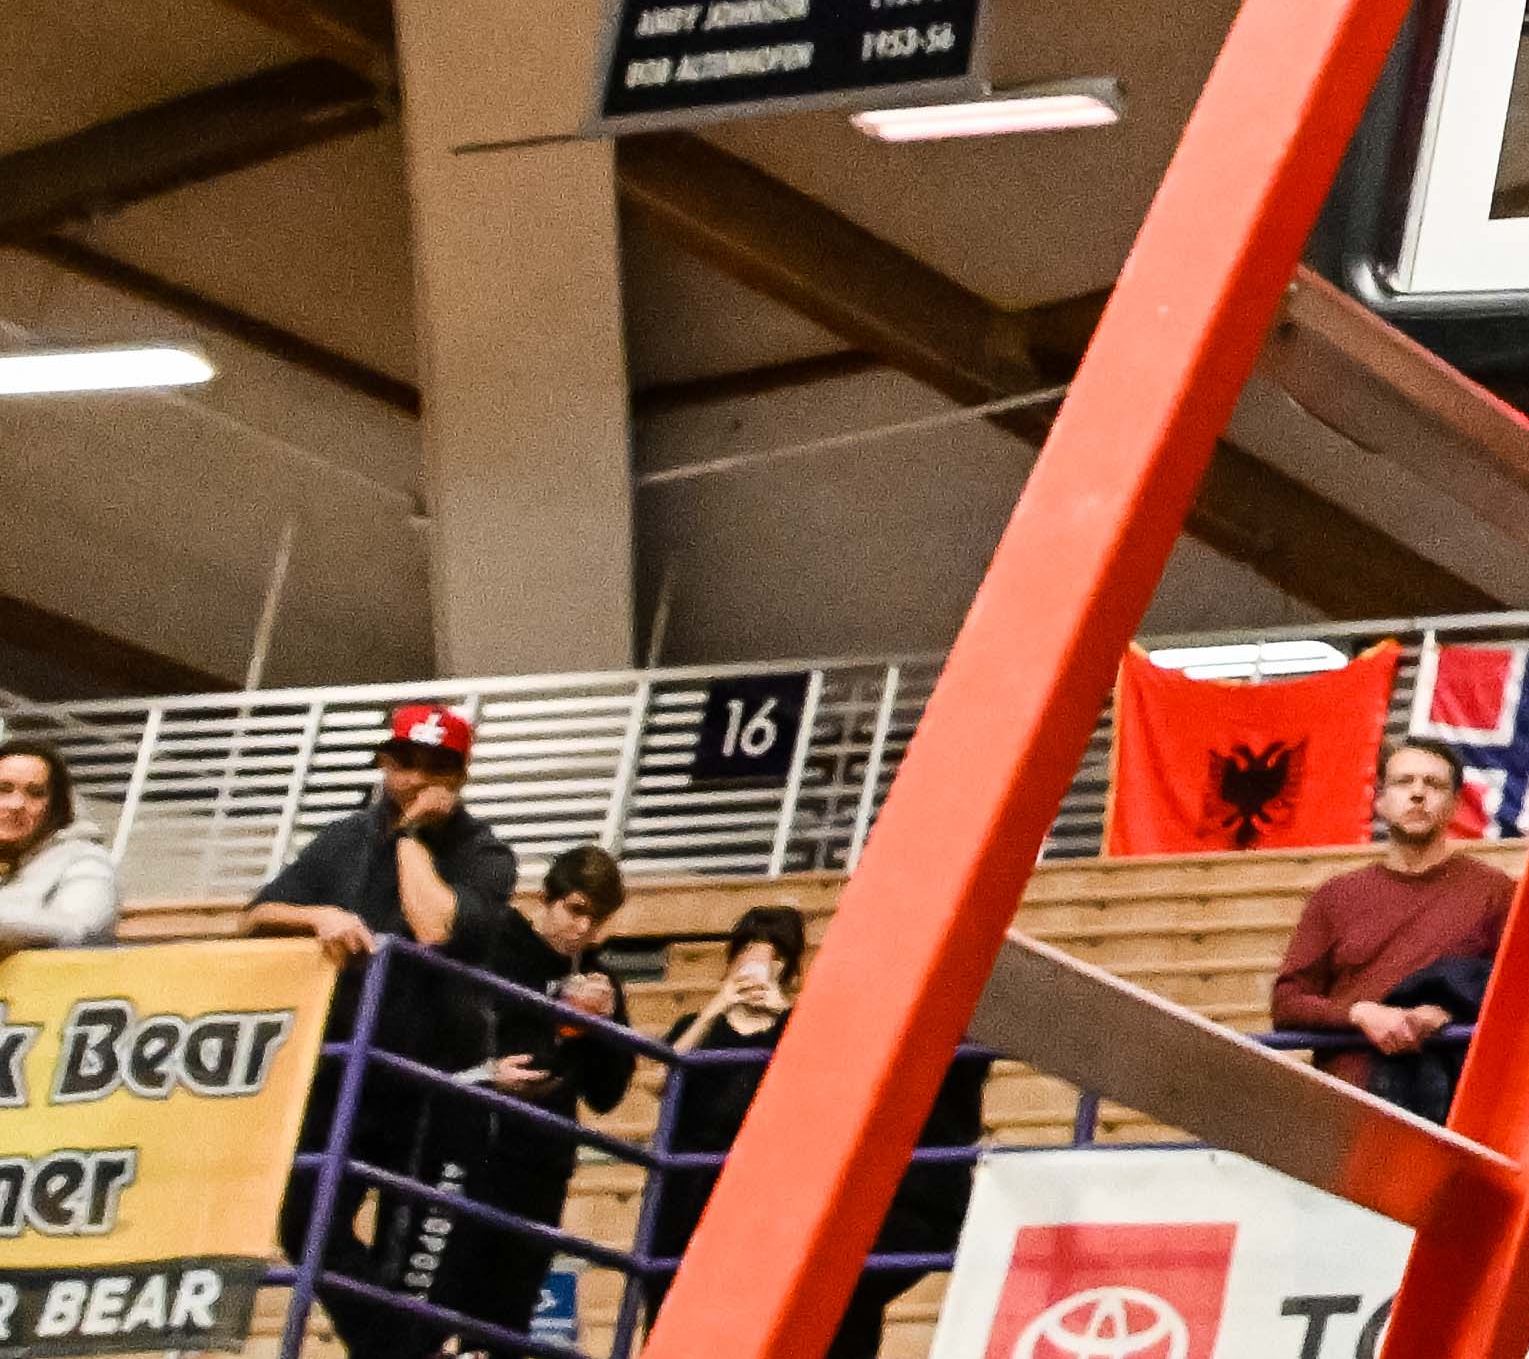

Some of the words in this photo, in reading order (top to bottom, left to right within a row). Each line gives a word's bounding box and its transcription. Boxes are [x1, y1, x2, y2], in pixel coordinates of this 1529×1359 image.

[722, 698, 779, 757] 16
[50, 995, 297, 1108] Bear
[35, 1267, 223, 1339] BEAR
